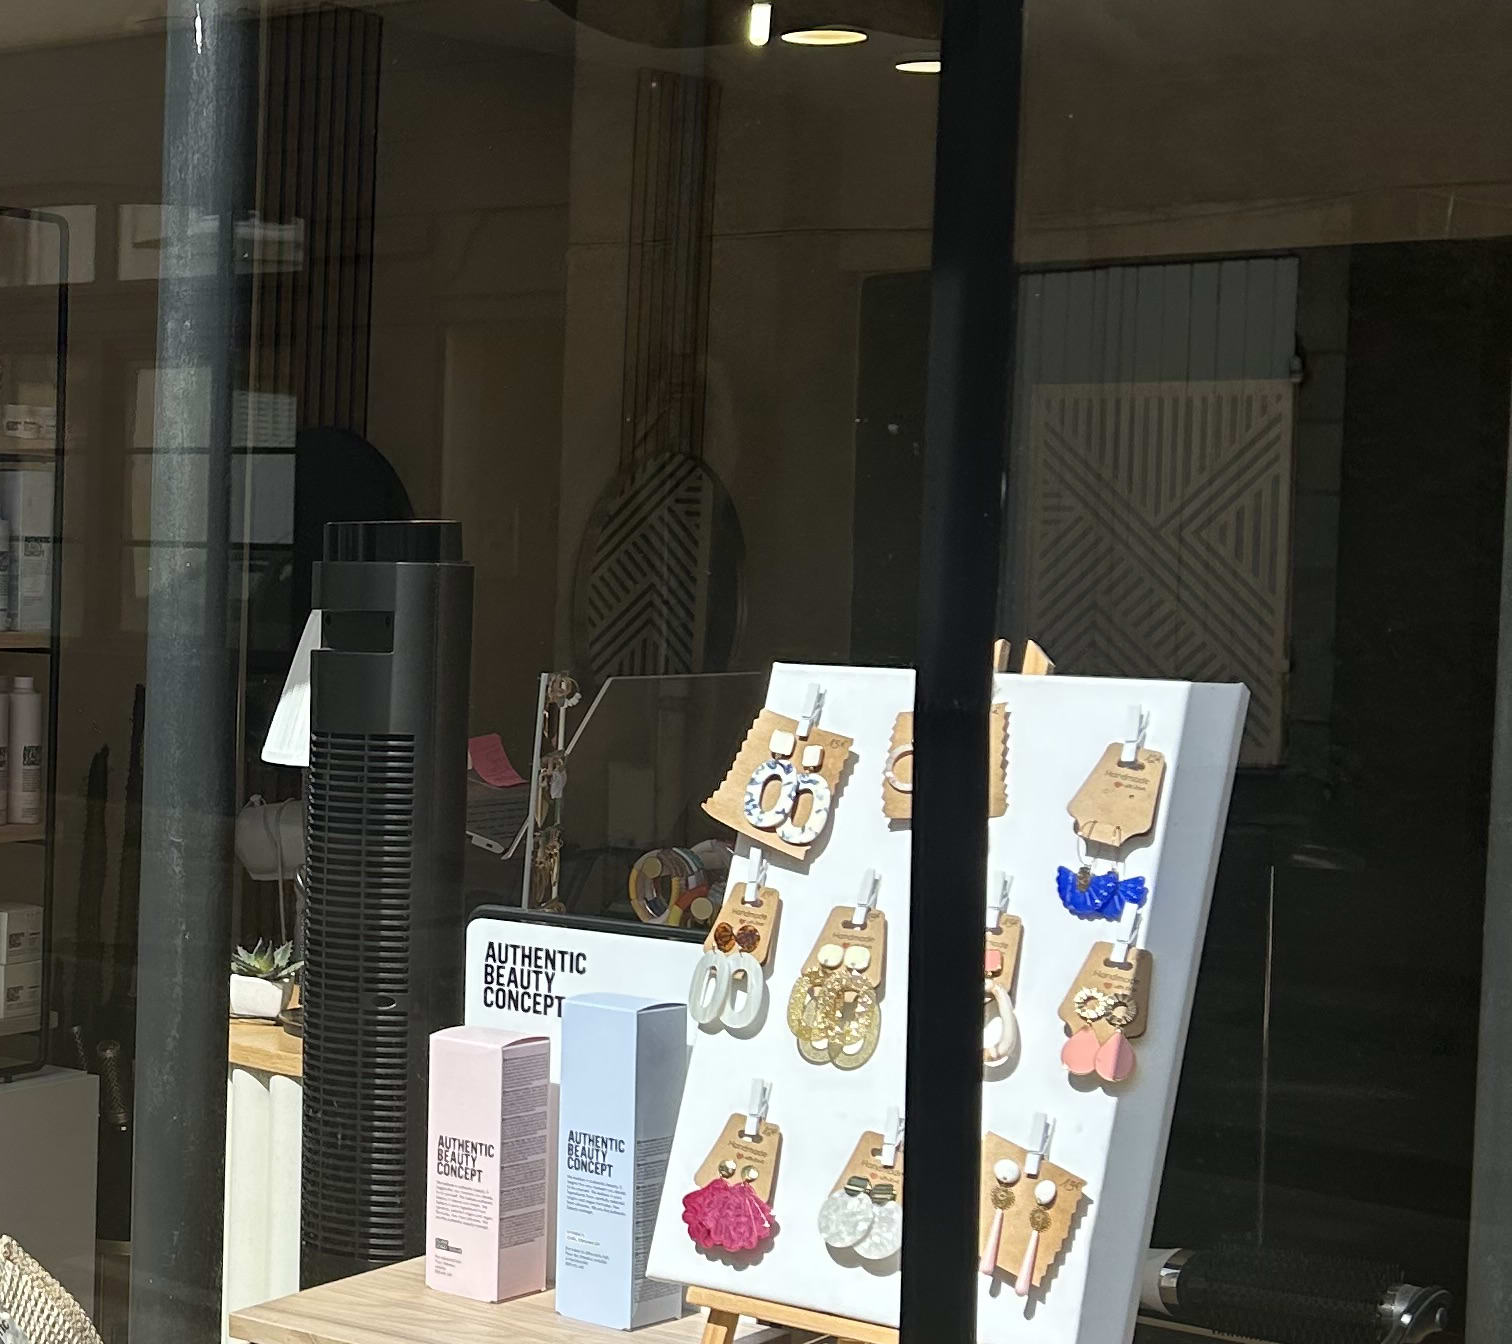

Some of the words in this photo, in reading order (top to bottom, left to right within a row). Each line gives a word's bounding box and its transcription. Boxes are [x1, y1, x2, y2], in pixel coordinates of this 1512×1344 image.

[485, 941, 587, 975] AUTHENTIC
[484, 963, 556, 994] BEAUTY
[484, 986, 566, 1018] CONCEPT
[437, 1135, 495, 1159] AUTHENTIC
[567, 1129, 626, 1153] AUTHENTIC
[437, 1149, 478, 1169] BEAUTY
[567, 1143, 609, 1164] BEAUTY
[436, 1162, 484, 1184] CONCEPT
[567, 1156, 614, 1178] CONCEPT
